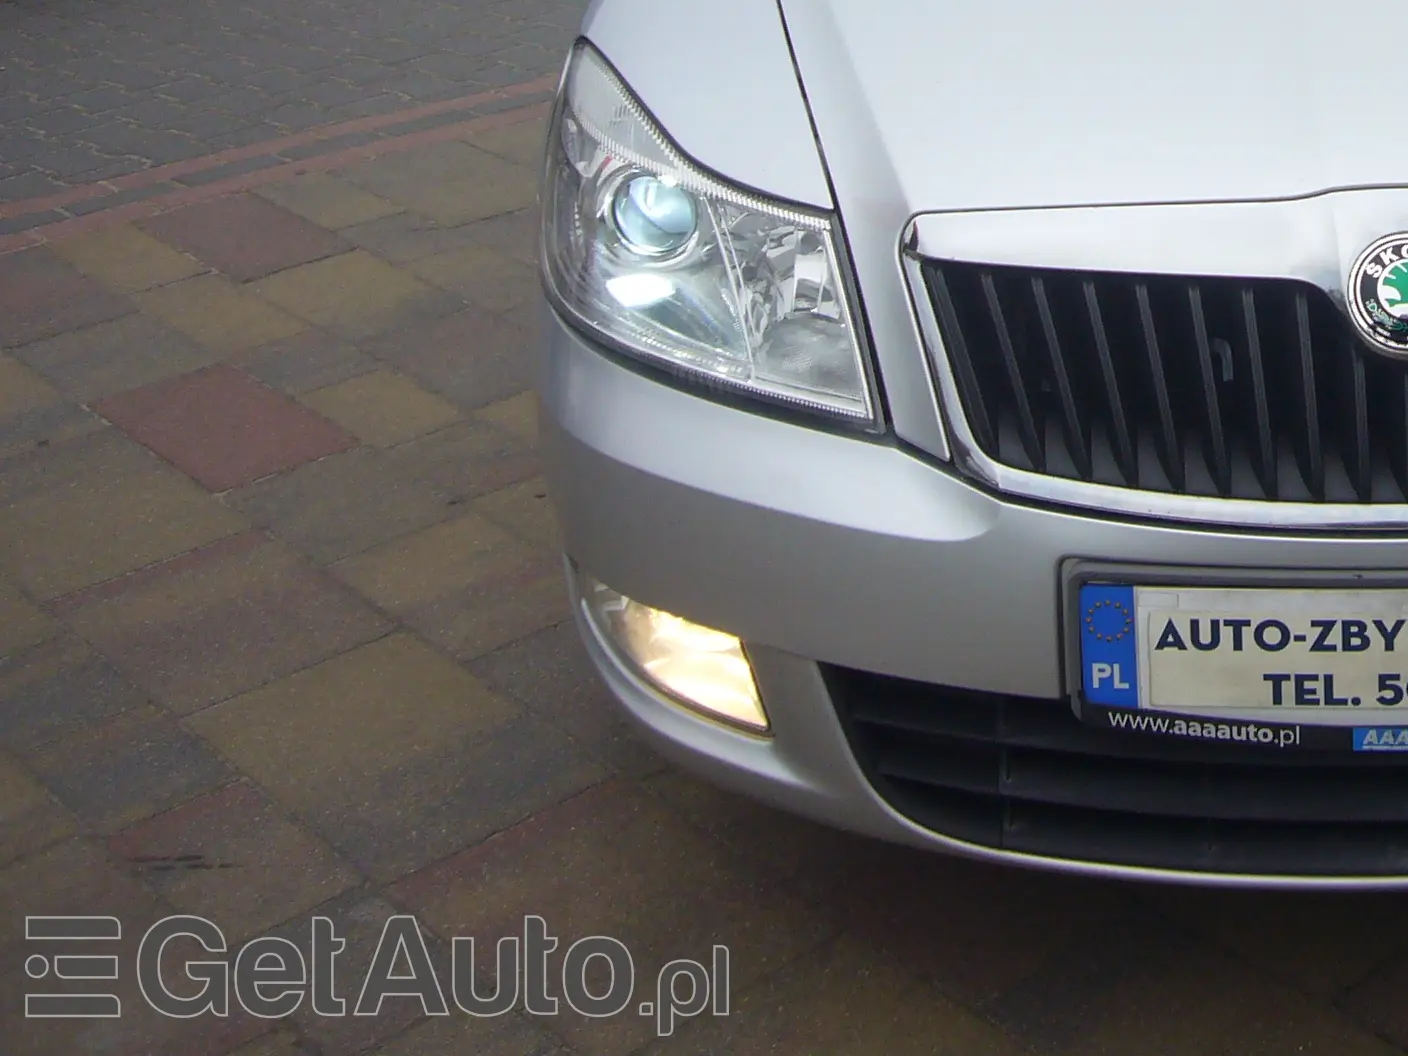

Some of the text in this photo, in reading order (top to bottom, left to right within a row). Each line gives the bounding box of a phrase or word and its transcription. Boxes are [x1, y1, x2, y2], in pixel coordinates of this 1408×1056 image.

[1091, 661, 1130, 691] PL
[1263, 672, 1362, 709] TEL.
[1108, 710, 1301, 746] www.aaaauto.pl
